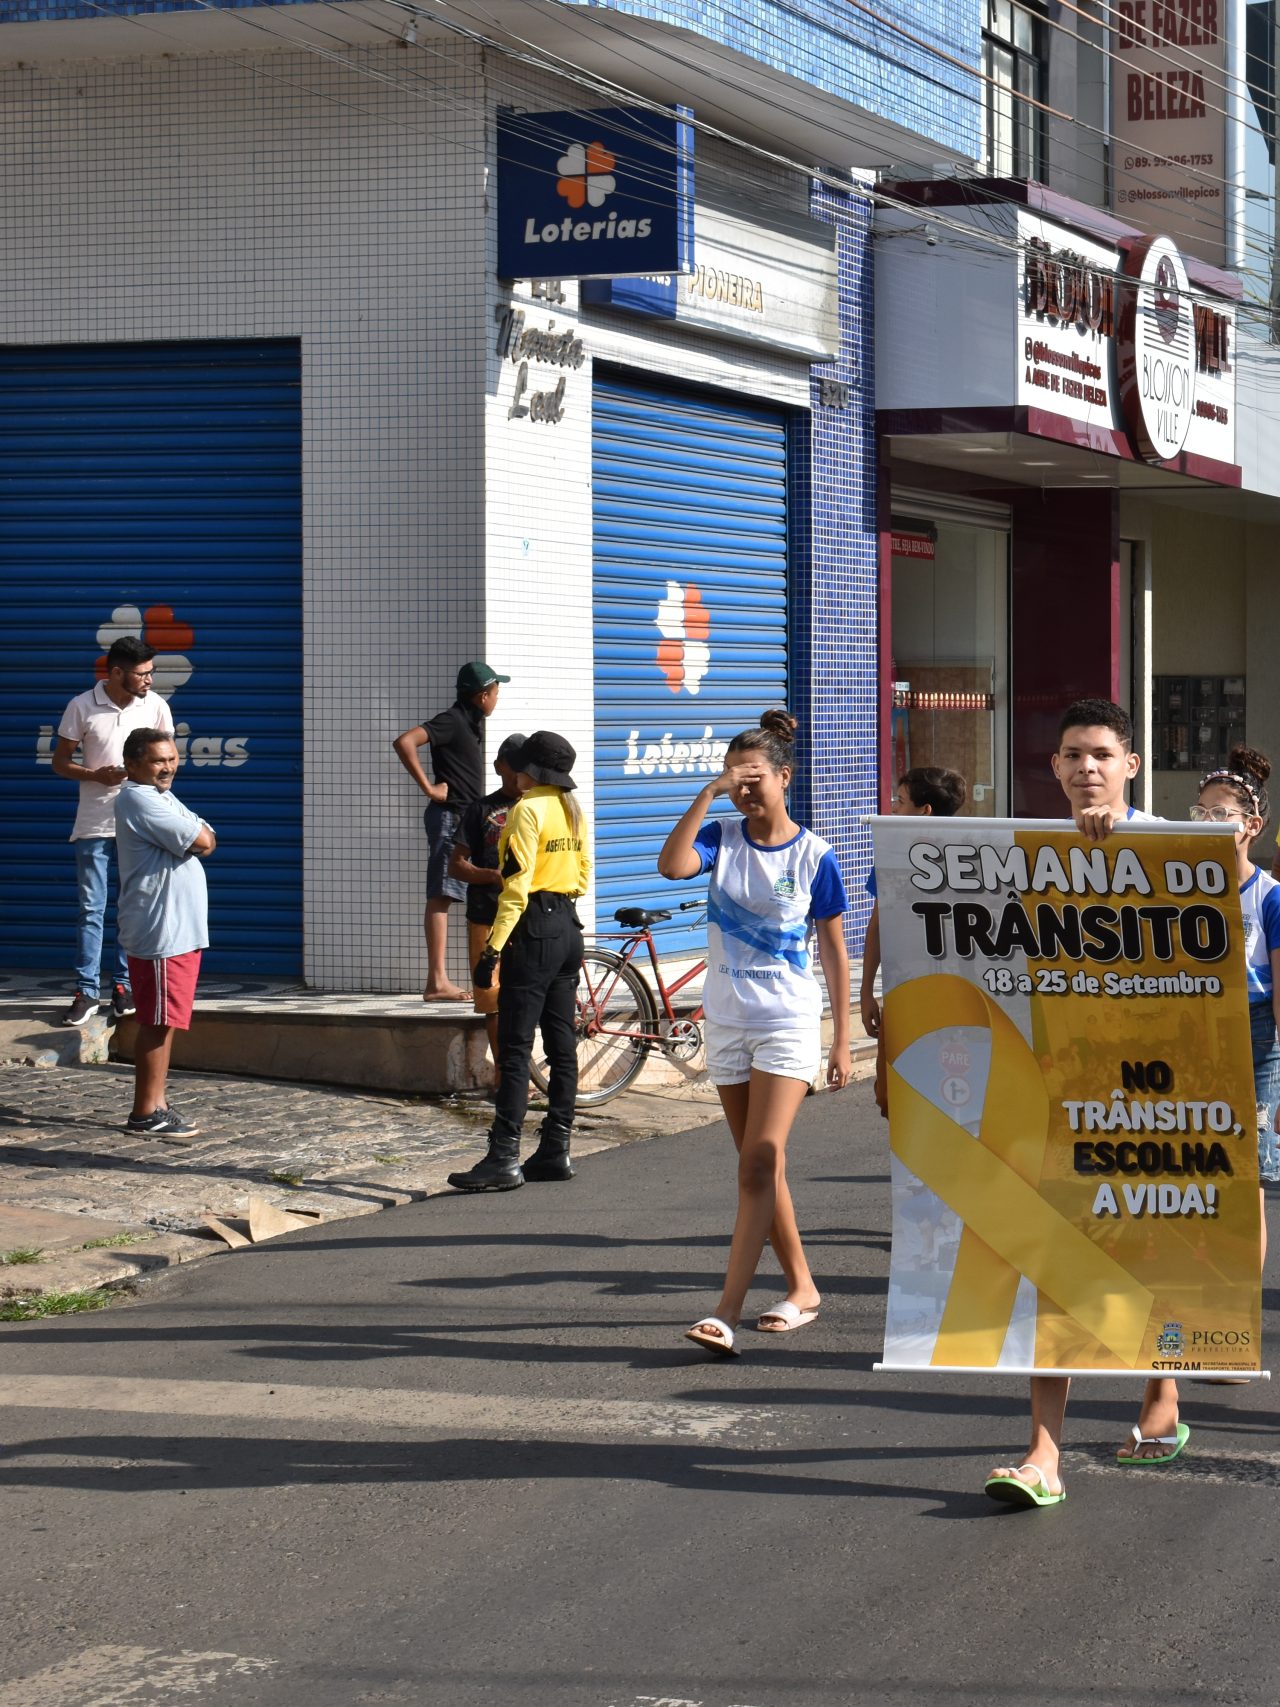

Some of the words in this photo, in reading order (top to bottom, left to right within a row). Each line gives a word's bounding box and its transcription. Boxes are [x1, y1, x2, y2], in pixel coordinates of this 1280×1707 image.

[1119, 1, 1146, 49] DE
[1152, 0, 1217, 47] FAZER
[1127, 70, 1206, 121] BELEZA
[524, 211, 652, 244] Loterias
[688, 263, 763, 313] PIONEIRA
[820, 379, 849, 409] 520
[1025, 365, 1031, 384] A
[1051, 373, 1060, 393] DE
[1158, 408, 1178, 445] VILLE
[908, 842, 1152, 896] SEMANA
[1163, 860, 1226, 895] DO
[911, 890, 1229, 962] TRÂNSITO
[732, 968, 784, 980] MUNICIPAL
[983, 968, 1013, 993] 18
[1015, 974, 1032, 993] a
[1036, 969, 1068, 994] 25
[1071, 970, 1099, 994] de
[1104, 970, 1221, 996] Setembro
[941, 1051, 969, 1067] PARE
[1120, 1060, 1170, 1090] NO
[1062, 1089, 1242, 1135] TRÂNSITO,
[1073, 1141, 1230, 1173] ESCOLHA
[1092, 1184, 1117, 1214] A
[1122, 1184, 1216, 1215] VIDA!
[1192, 1331, 1250, 1345] PICOS
